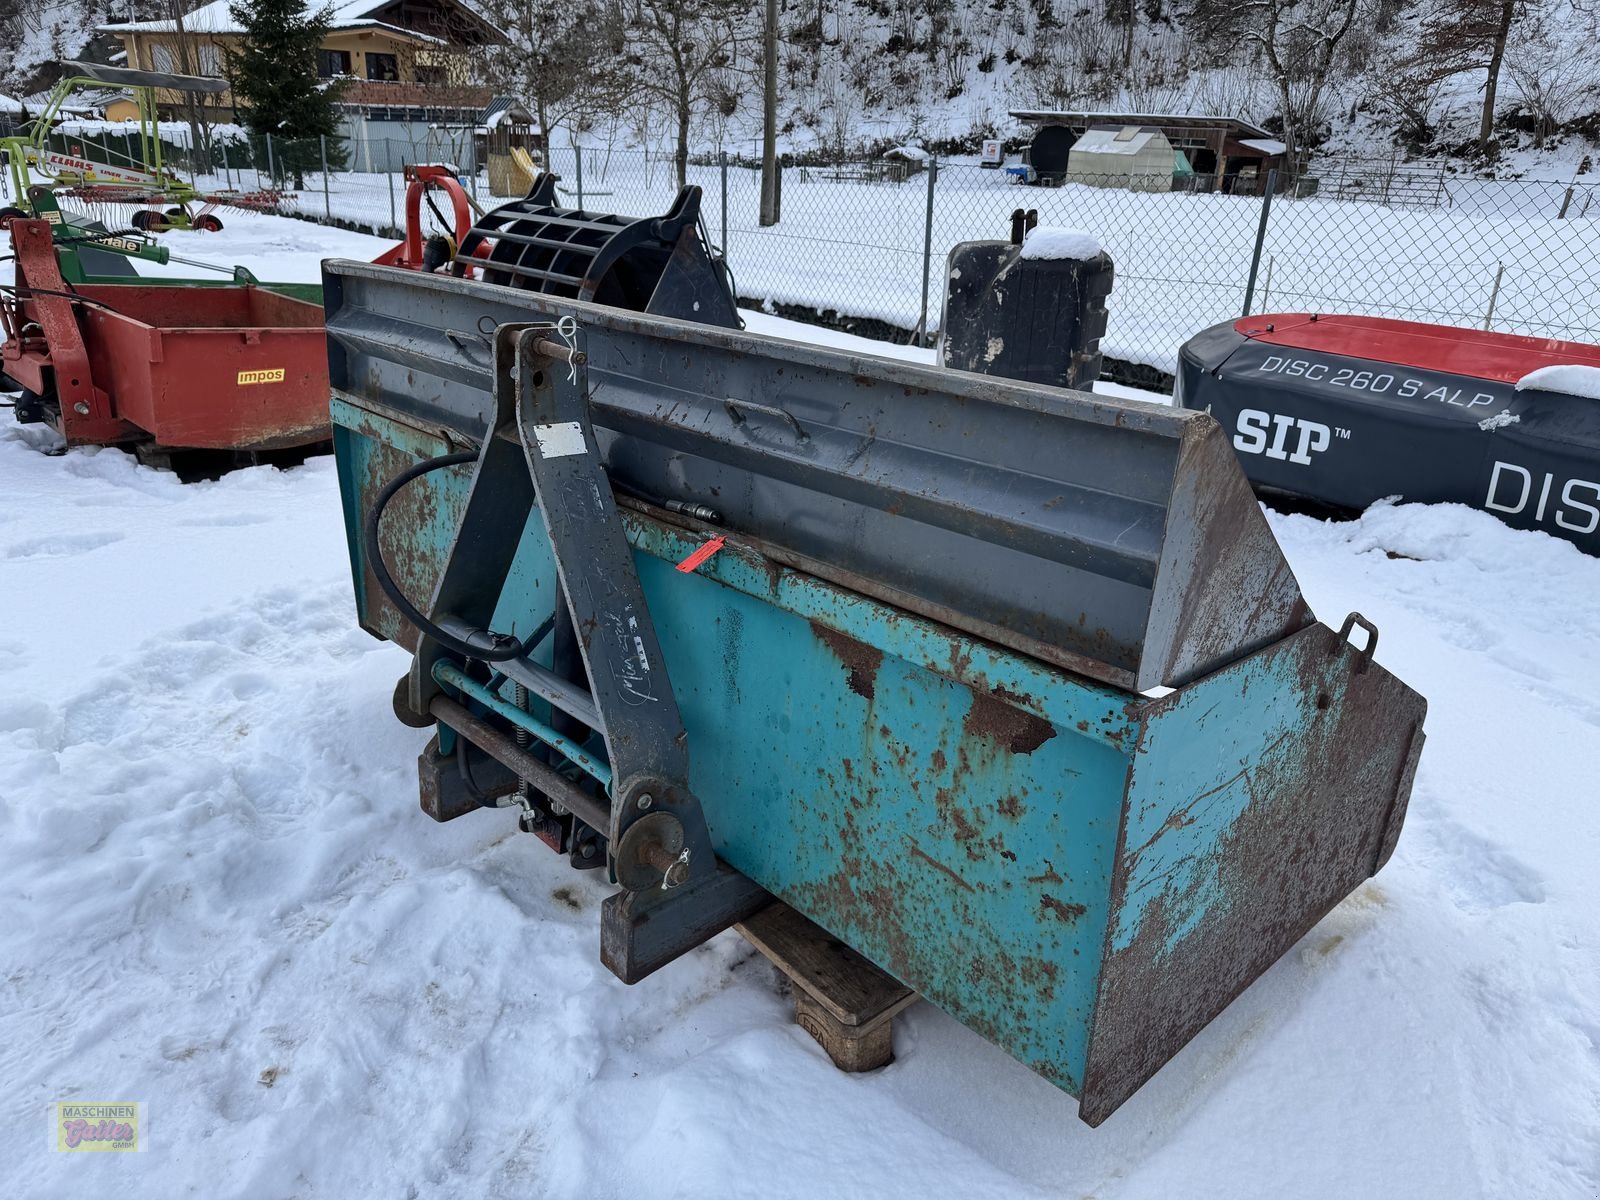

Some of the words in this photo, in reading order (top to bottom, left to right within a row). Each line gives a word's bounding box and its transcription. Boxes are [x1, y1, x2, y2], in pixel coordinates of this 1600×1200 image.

[50, 155, 94, 171] CLAAS
[240, 370, 283, 383] impos
[1259, 356, 1329, 381] DISC
[1329, 368, 1394, 393] 260
[1397, 379, 1423, 398] S
[1424, 386, 1495, 409] ALP
[1233, 408, 1331, 466] SIP
[1484, 460, 1600, 534] DIS
